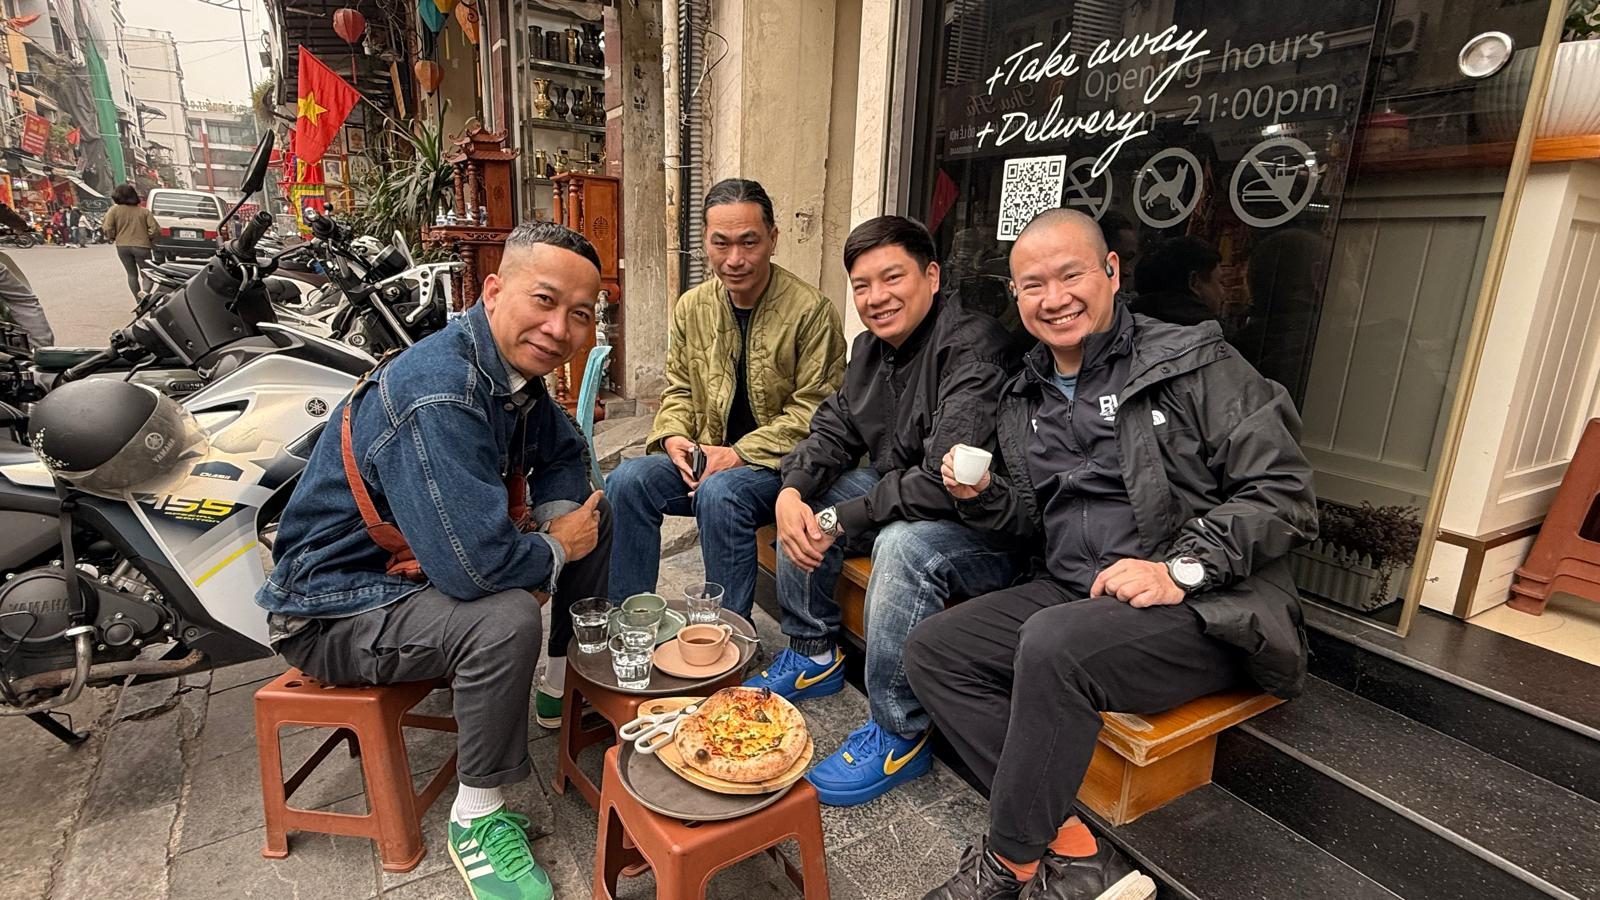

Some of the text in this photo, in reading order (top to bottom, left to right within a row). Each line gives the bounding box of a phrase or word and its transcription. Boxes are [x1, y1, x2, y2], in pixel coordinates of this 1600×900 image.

[1087, 25, 1210, 104] away
[1221, 31, 1325, 72] hours
[1183, 82, 1338, 126] 21:00pm
[152, 438, 176, 463] YAMAHA
